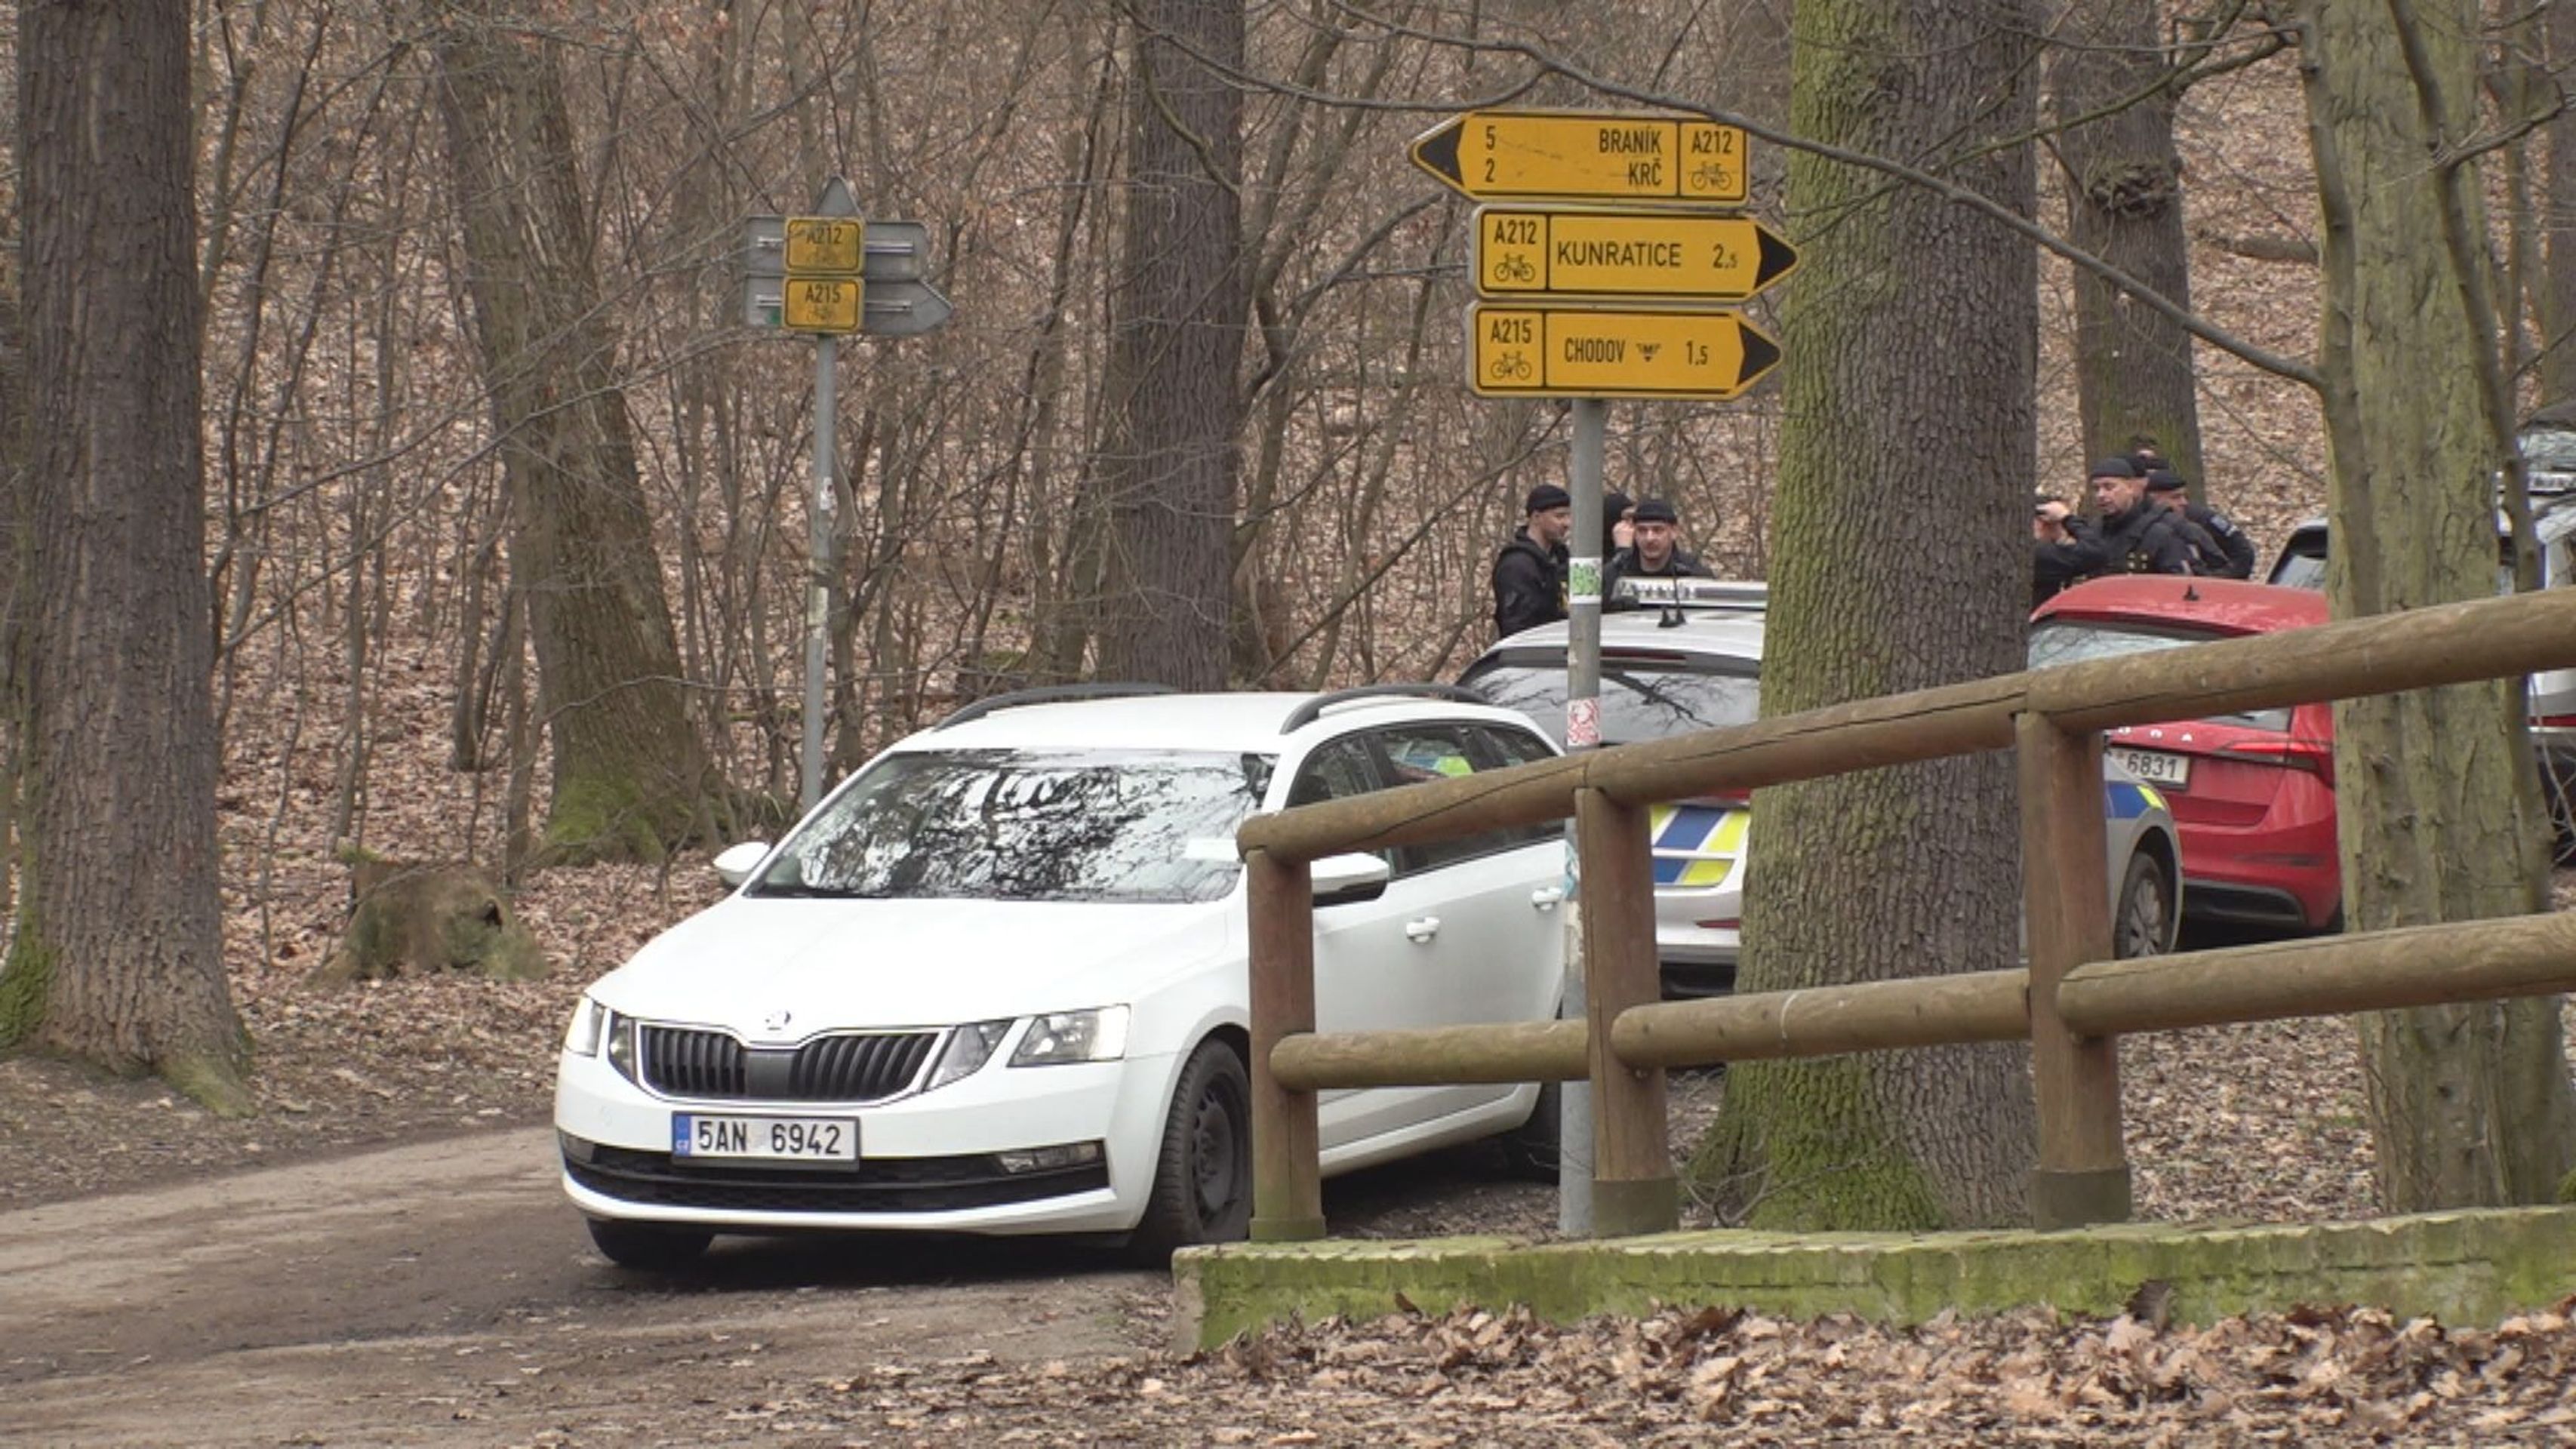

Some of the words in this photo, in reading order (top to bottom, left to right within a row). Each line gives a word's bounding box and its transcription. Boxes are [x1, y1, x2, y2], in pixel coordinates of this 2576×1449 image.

[1485, 126, 1496, 150] 5
[1599, 125, 1662, 154] BRANÍK
[1691, 131, 1733, 154] A212
[1485, 159, 1495, 183] 2
[1628, 158, 1662, 186] KRČ
[805, 226, 842, 245] A212
[1494, 220, 1537, 245] A212
[1557, 242, 1682, 268] KUNRATICE
[805, 285, 841, 303] A215
[1491, 319, 1532, 344] A215
[1564, 338, 1626, 364] CHODOV
[2127, 753, 2177, 779] 6831
[698, 1121, 747, 1152] 5AN
[771, 1123, 841, 1155] 6942
